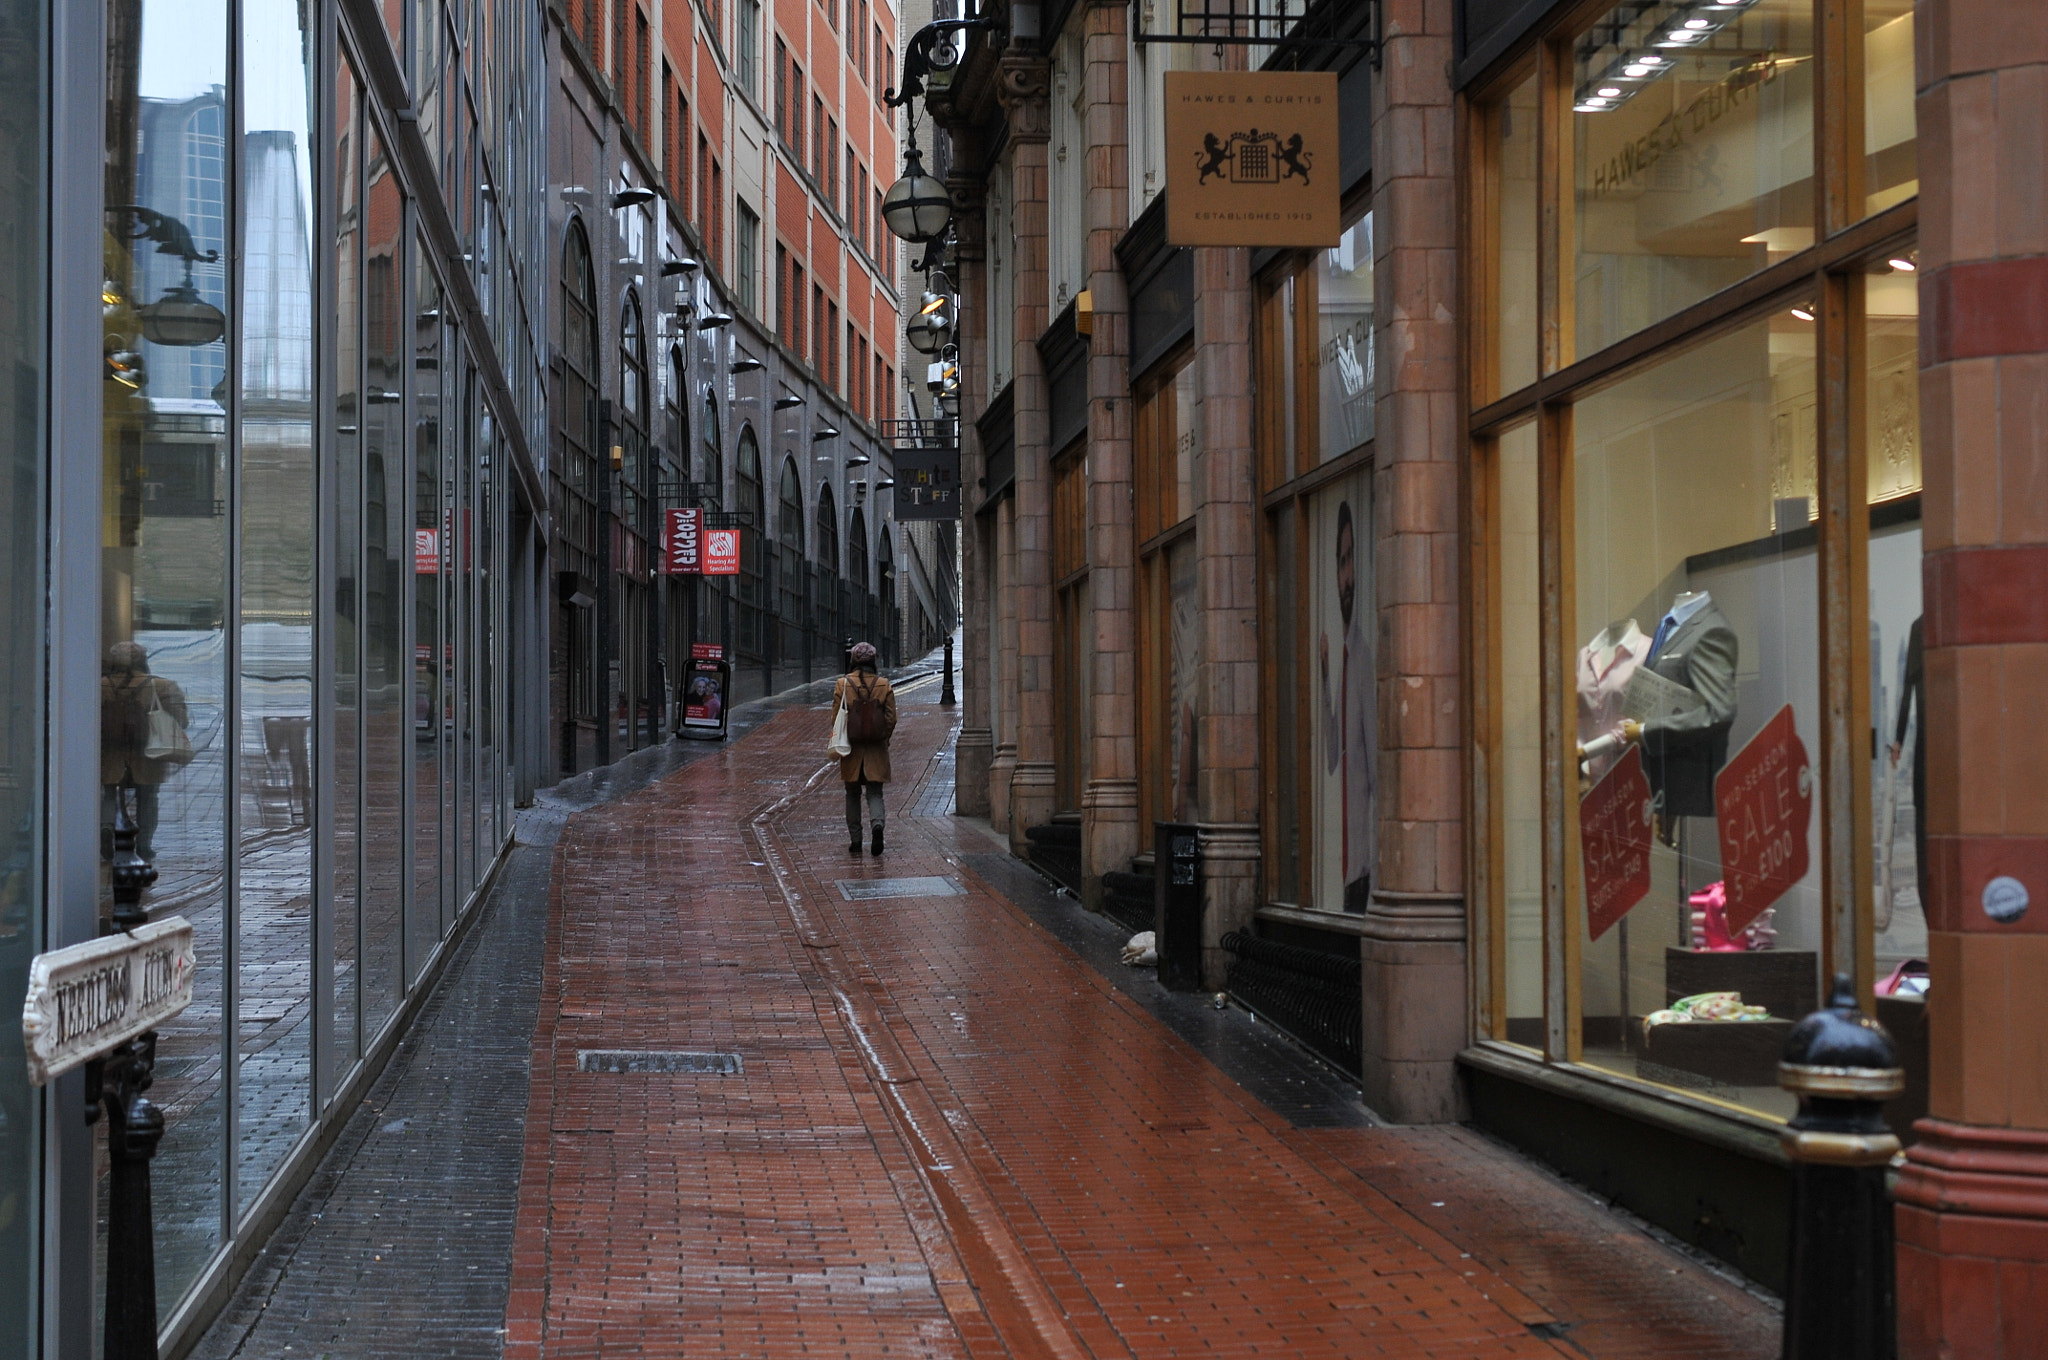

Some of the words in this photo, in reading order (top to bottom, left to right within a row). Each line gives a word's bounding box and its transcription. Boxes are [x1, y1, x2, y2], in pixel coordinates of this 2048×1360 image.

[1182, 95, 1235, 103] HAWES
[1246, 95, 1253, 103] &
[1264, 95, 1322, 104] CURTIS
[1594, 127, 1661, 198] HAWES
[1672, 113, 1683, 148] &
[1692, 48, 1777, 134] CURTIS
[1194, 212, 1281, 221] ESTABLISHED
[1287, 213, 1312, 221] 1913
[1723, 743, 1787, 813] MID-SEASON
[1725, 766, 1793, 867] SALE
[1587, 800, 1640, 883] SALE
[1734, 873, 1744, 902] 5
[1758, 829, 1793, 881] £100
[55, 966, 127, 1047] NEEDLESS
[140, 948, 174, 1010] ALLEY
